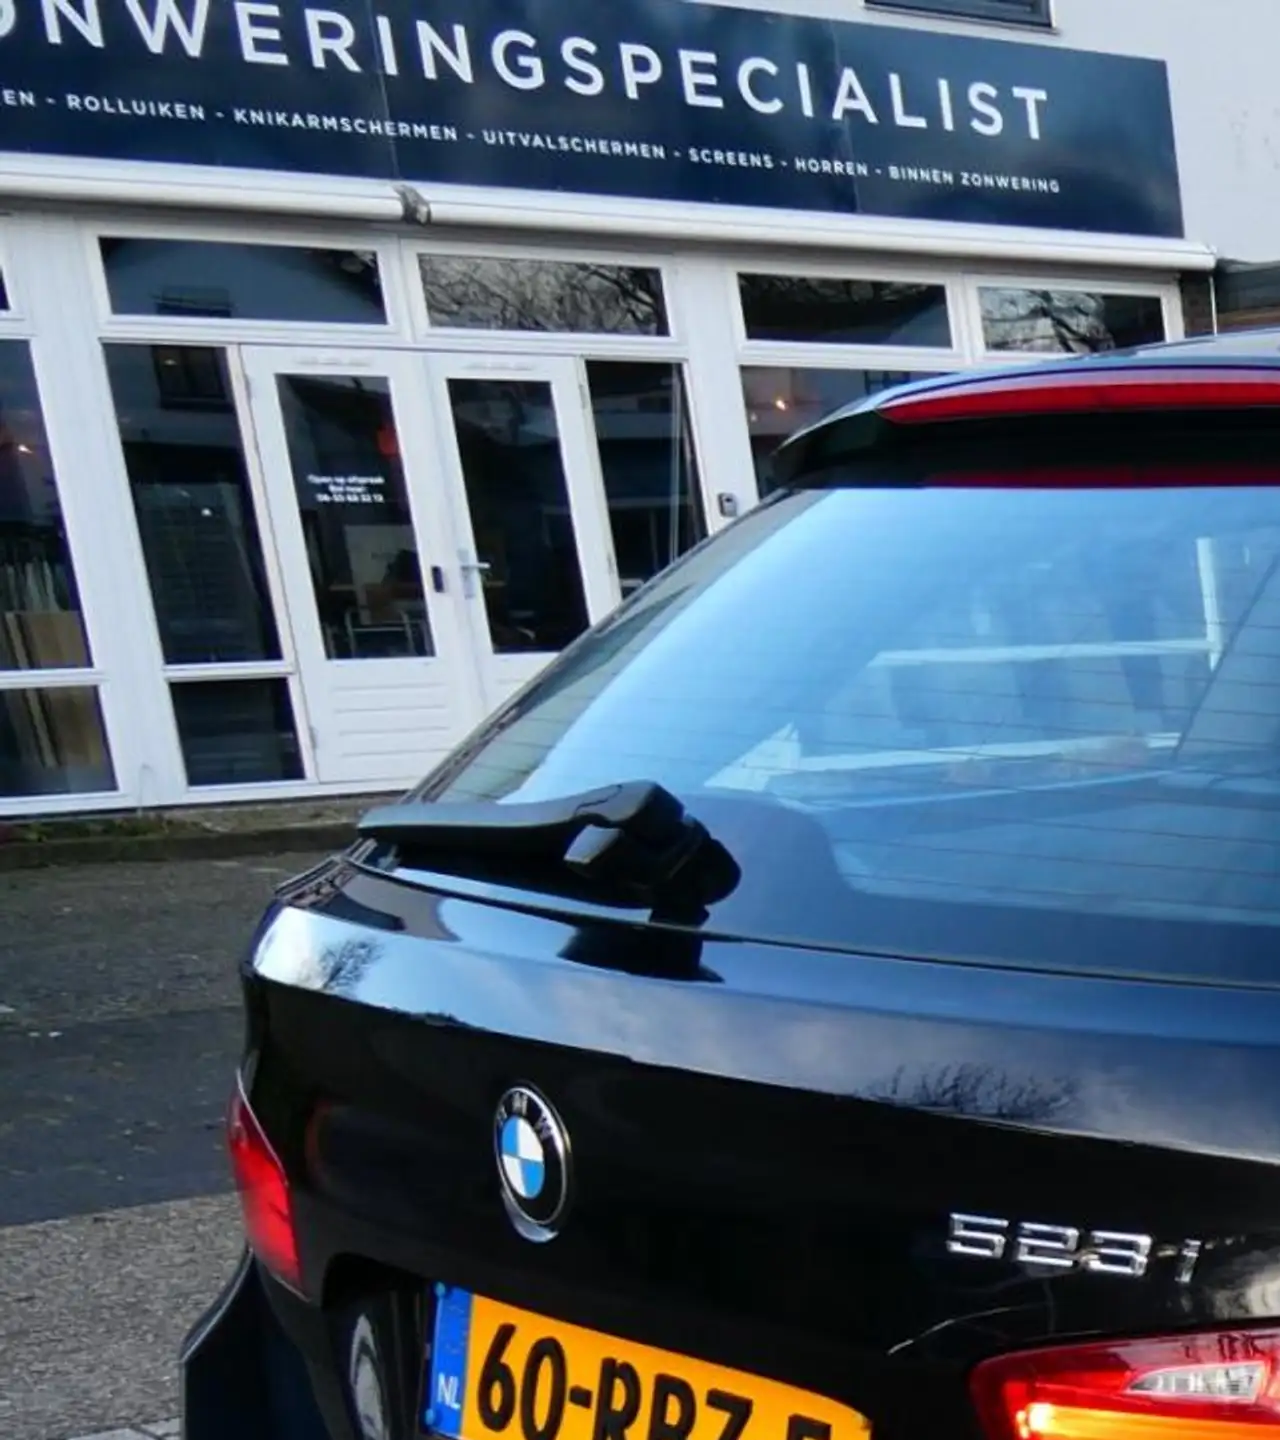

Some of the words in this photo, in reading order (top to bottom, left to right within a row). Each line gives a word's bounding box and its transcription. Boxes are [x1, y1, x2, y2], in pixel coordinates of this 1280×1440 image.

[0, 0, 1048, 140] NWERINGSPECIALIST
[65, 93, 206, 121] ROLLUIKEN
[233, 107, 458, 141] KNIKARMSCHERMEN
[482, 129, 667, 160] UITVALSCHERMEN
[688, 147, 775, 170] SCREENS
[795, 156, 869, 178] HORREN
[888, 165, 955, 186] BINNEN
[960, 171, 1061, 194] ZONWERING
[436, 1372, 461, 1411] NL
